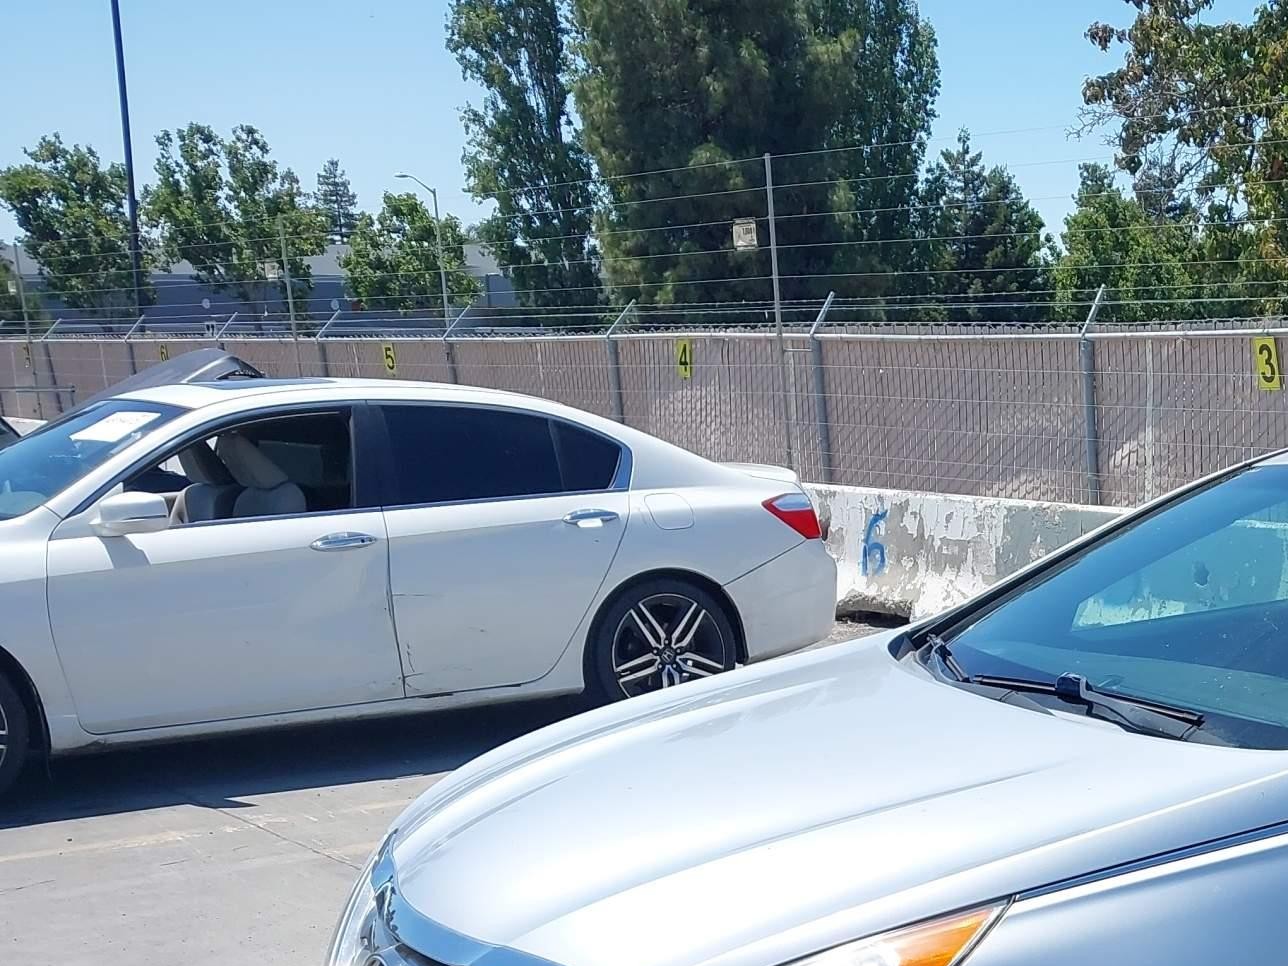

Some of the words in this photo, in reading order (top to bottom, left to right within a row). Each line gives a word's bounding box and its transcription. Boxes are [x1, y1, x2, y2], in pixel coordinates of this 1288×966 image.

[384, 346, 395, 370] 5
[679, 343, 689, 373] 4
[1259, 344, 1275, 383] 3
